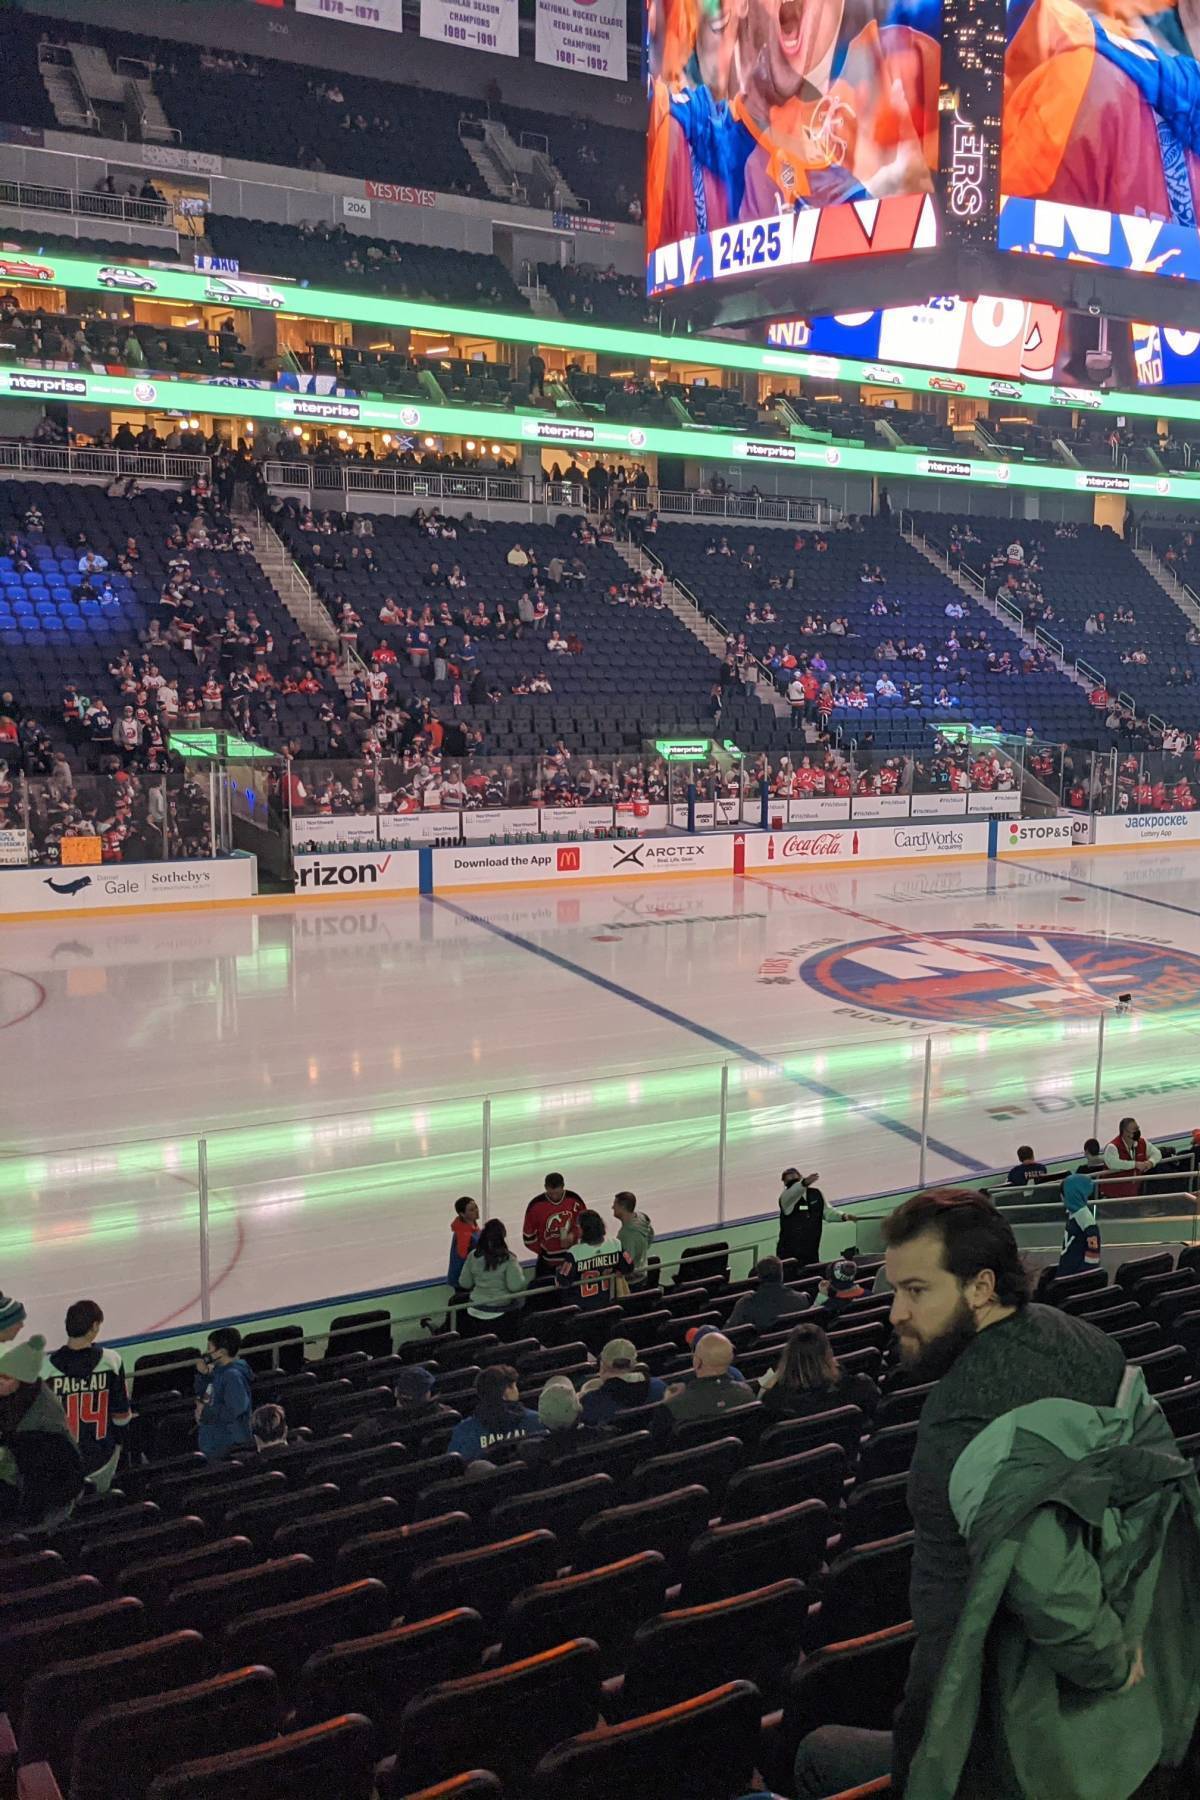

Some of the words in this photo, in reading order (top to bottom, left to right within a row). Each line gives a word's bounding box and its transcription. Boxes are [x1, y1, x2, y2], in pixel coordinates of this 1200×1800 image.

[449, 11, 491, 28] CHAMPIONS
[539, 1, 571, 17] NATIONAL
[572, 9, 598, 22] HOCKEY
[599, 15, 624, 28] LEAGUE
[553, 19, 583, 34] REGULAR
[584, 26, 610, 40] SEASON
[562, 36, 601, 53] CHAMPIONS
[370, 182, 392, 199] YES
[392, 186, 412, 203] YES
[414, 190, 435, 207] YES
[347, 202, 367, 214] 206
[719, 222, 781, 271] 24:25
[894, 828, 963, 852] CardWorks
[646, 846, 705, 858] ARCTIX
[454, 856, 510, 869] Download
[511, 856, 527, 867] the
[528, 854, 552, 869] App
[152, 870, 210, 884] Sotheby's
[105, 880, 139, 894] Gale
[577, 1252, 619, 1272] BATTINELLI
